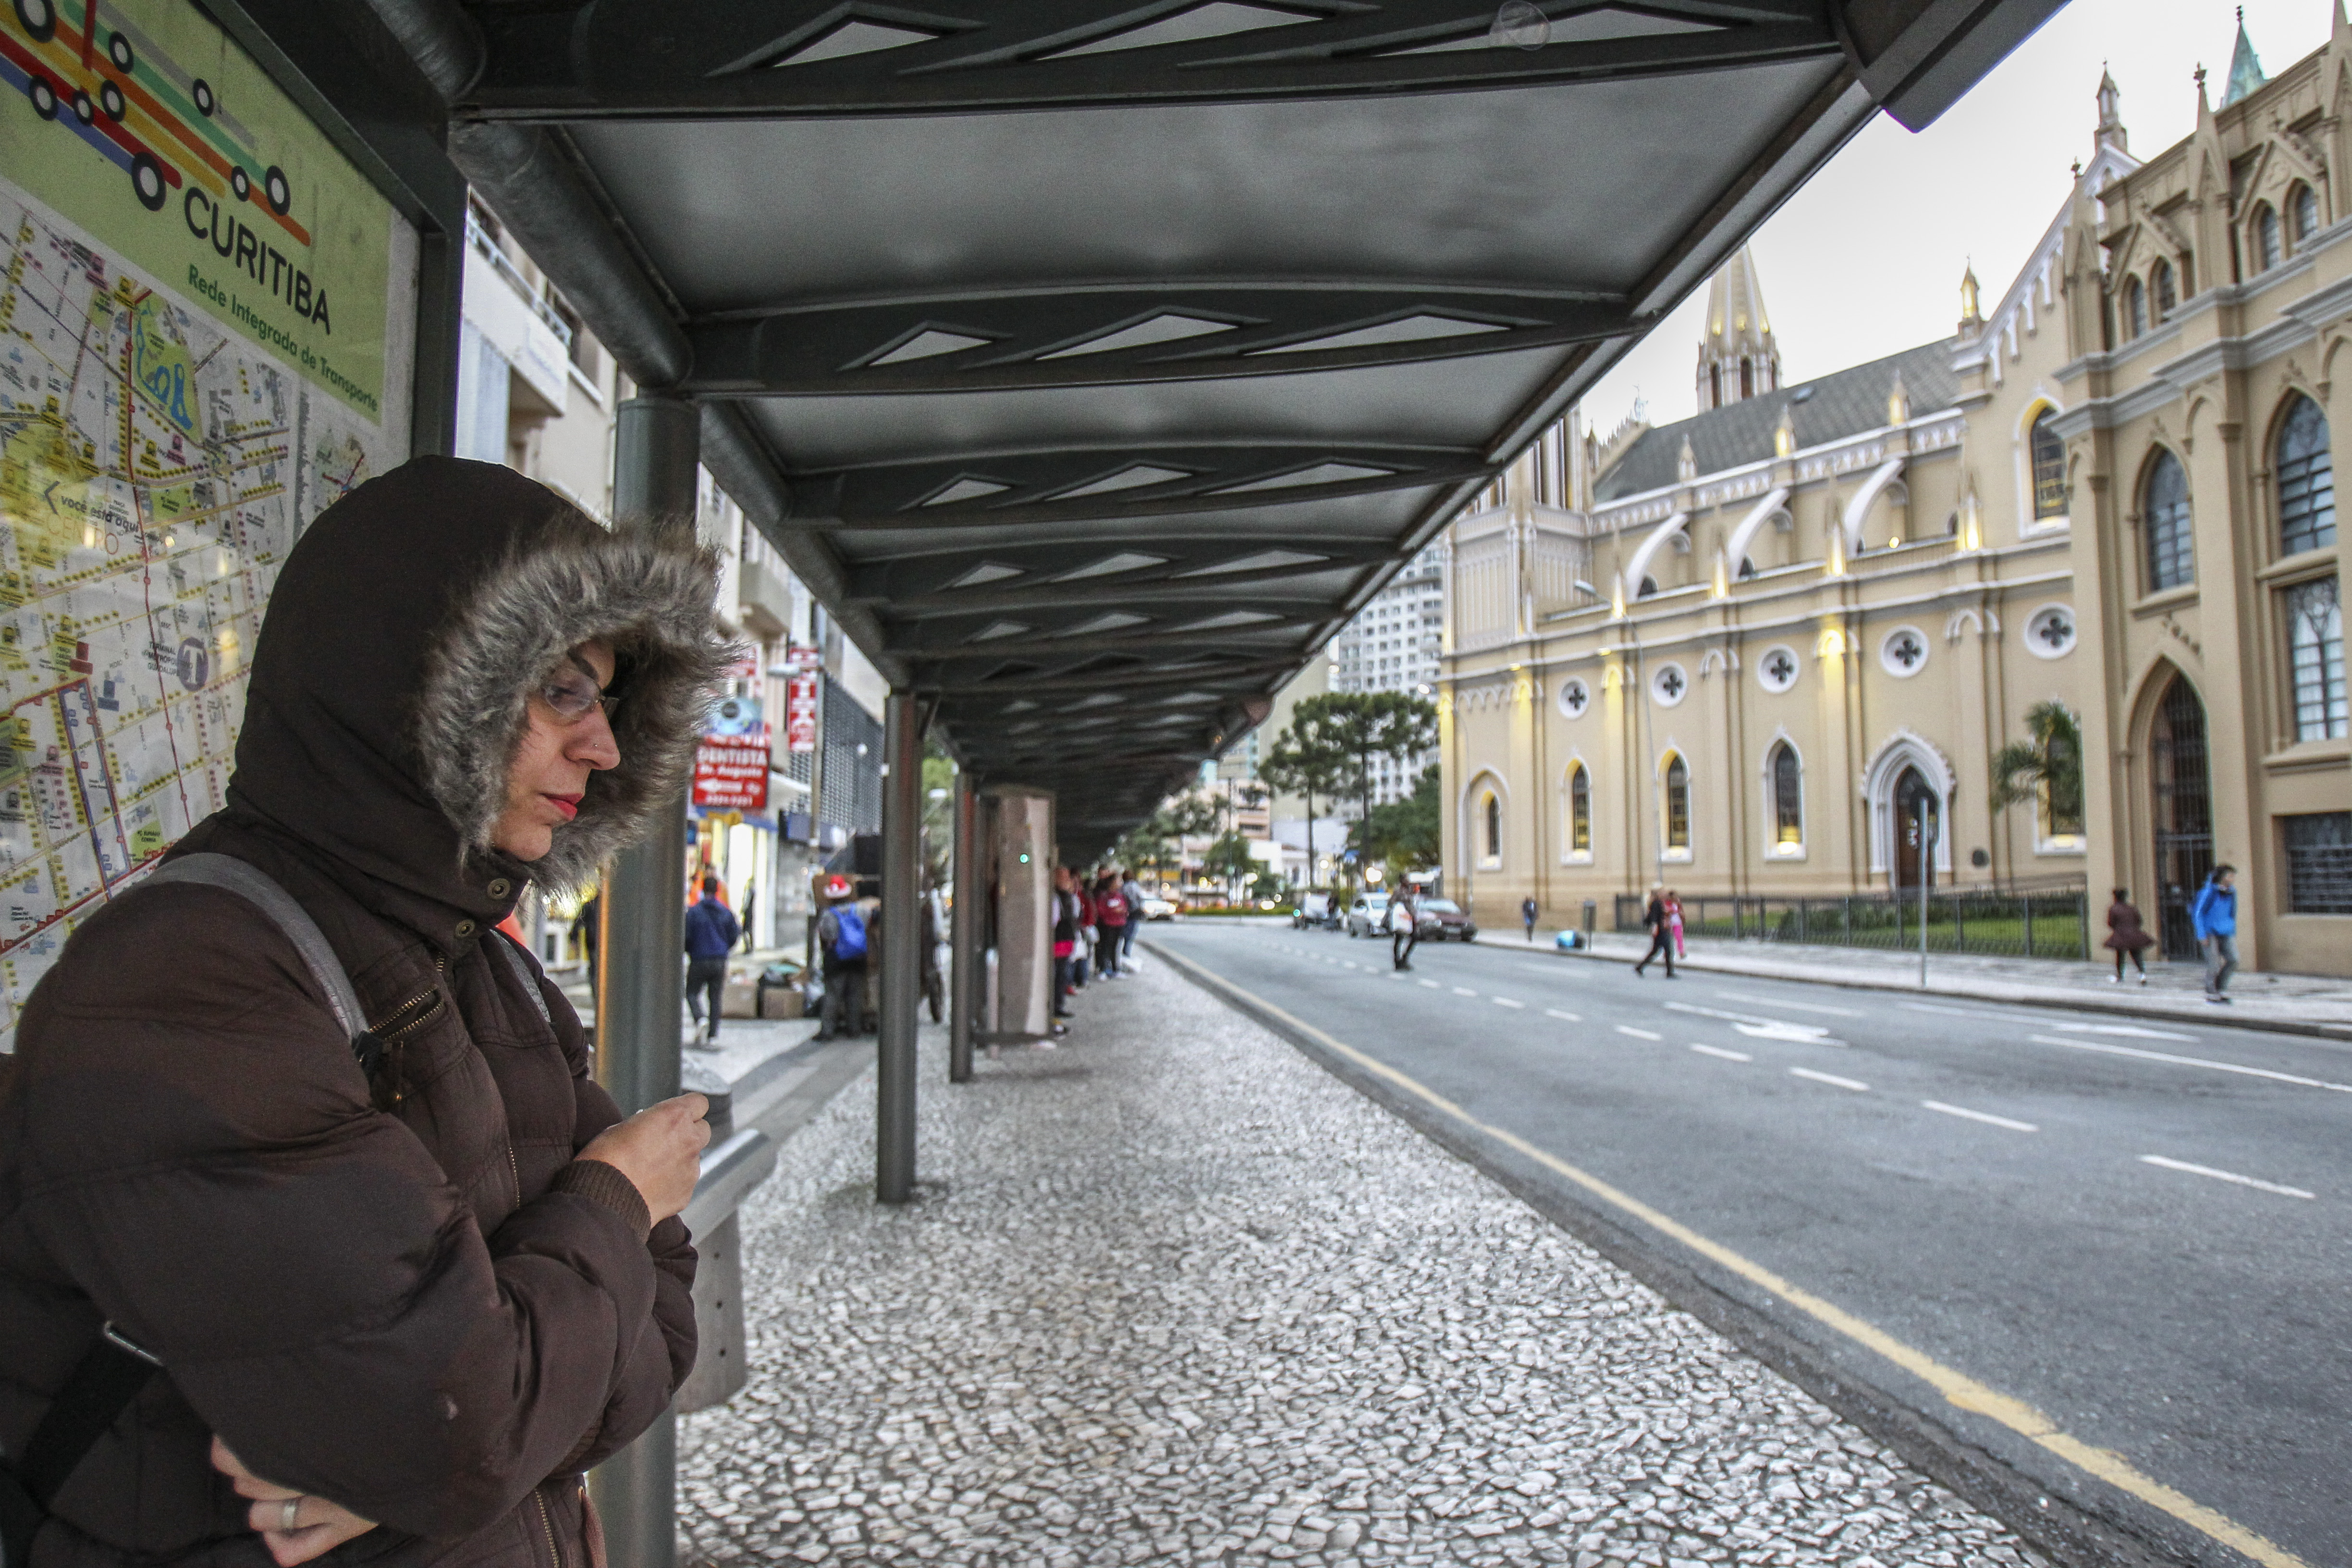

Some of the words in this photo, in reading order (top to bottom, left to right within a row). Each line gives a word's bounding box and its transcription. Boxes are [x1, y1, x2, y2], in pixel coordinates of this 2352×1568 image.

[184, 186, 331, 335] CURITIBA
[188, 264, 226, 307] Rede
[232, 294, 297, 356] Integrada
[301, 347, 317, 369] de
[320, 357, 378, 412] Transporte
[47, 513, 119, 555] CENRO
[61, 495, 87, 514] você
[115, 516, 139, 534] aqui
[698, 747, 767, 766] DENTISTA
